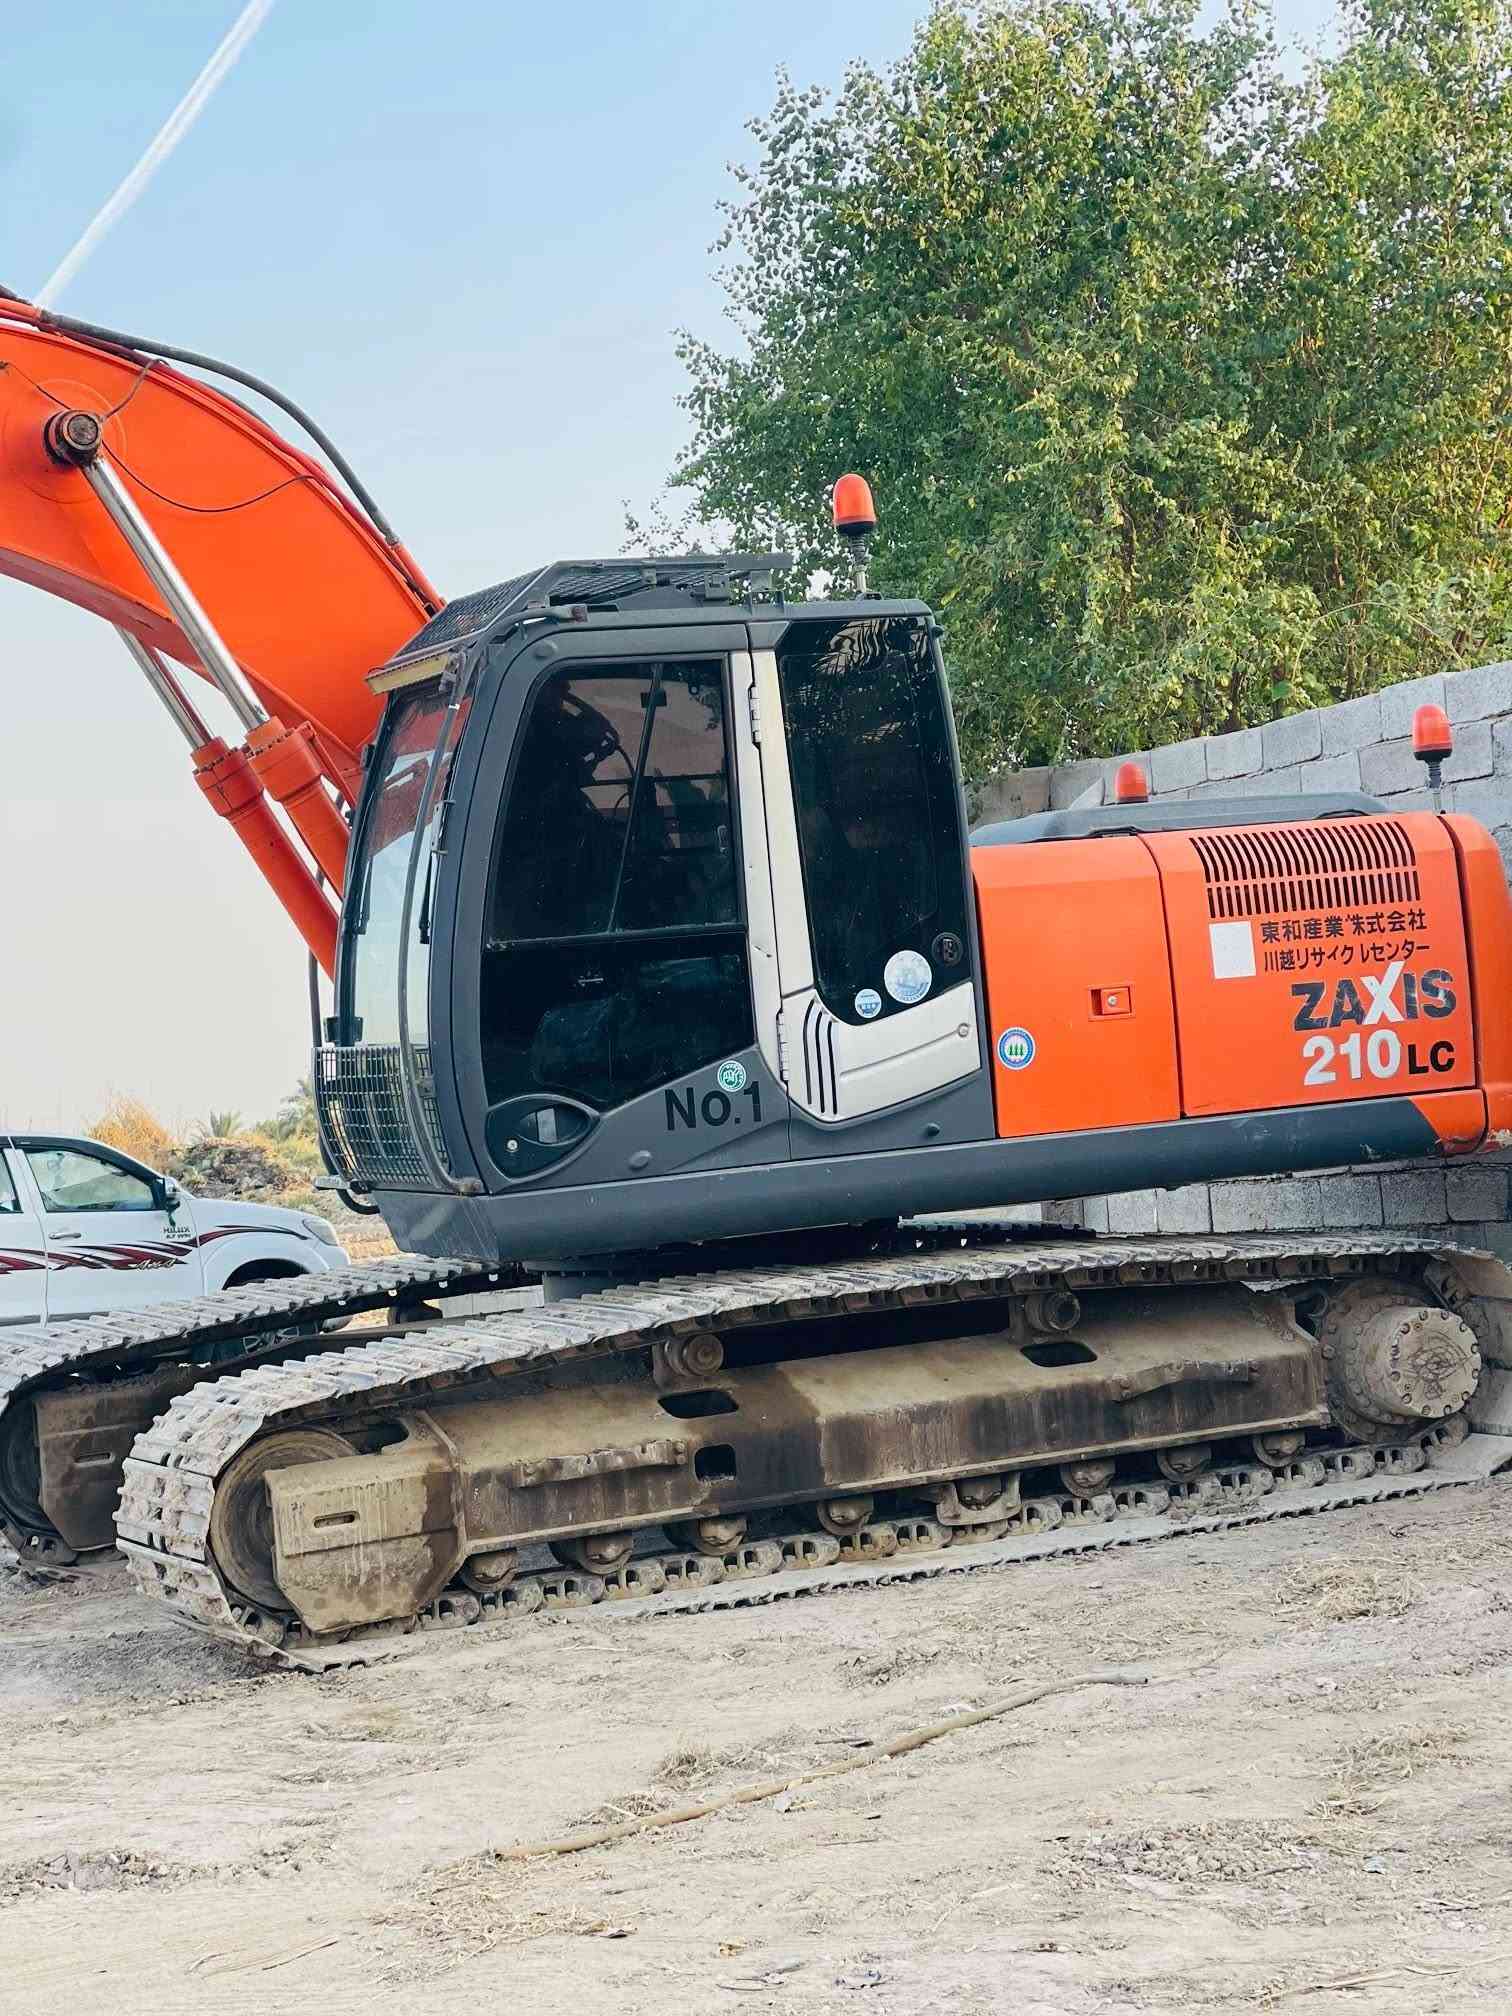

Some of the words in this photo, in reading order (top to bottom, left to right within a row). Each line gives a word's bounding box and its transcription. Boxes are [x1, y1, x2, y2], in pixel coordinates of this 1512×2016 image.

[1291, 961, 1458, 1031] ZAXIS
[1303, 1029, 1401, 1086] 210
[1407, 1041, 1456, 1075] LC
